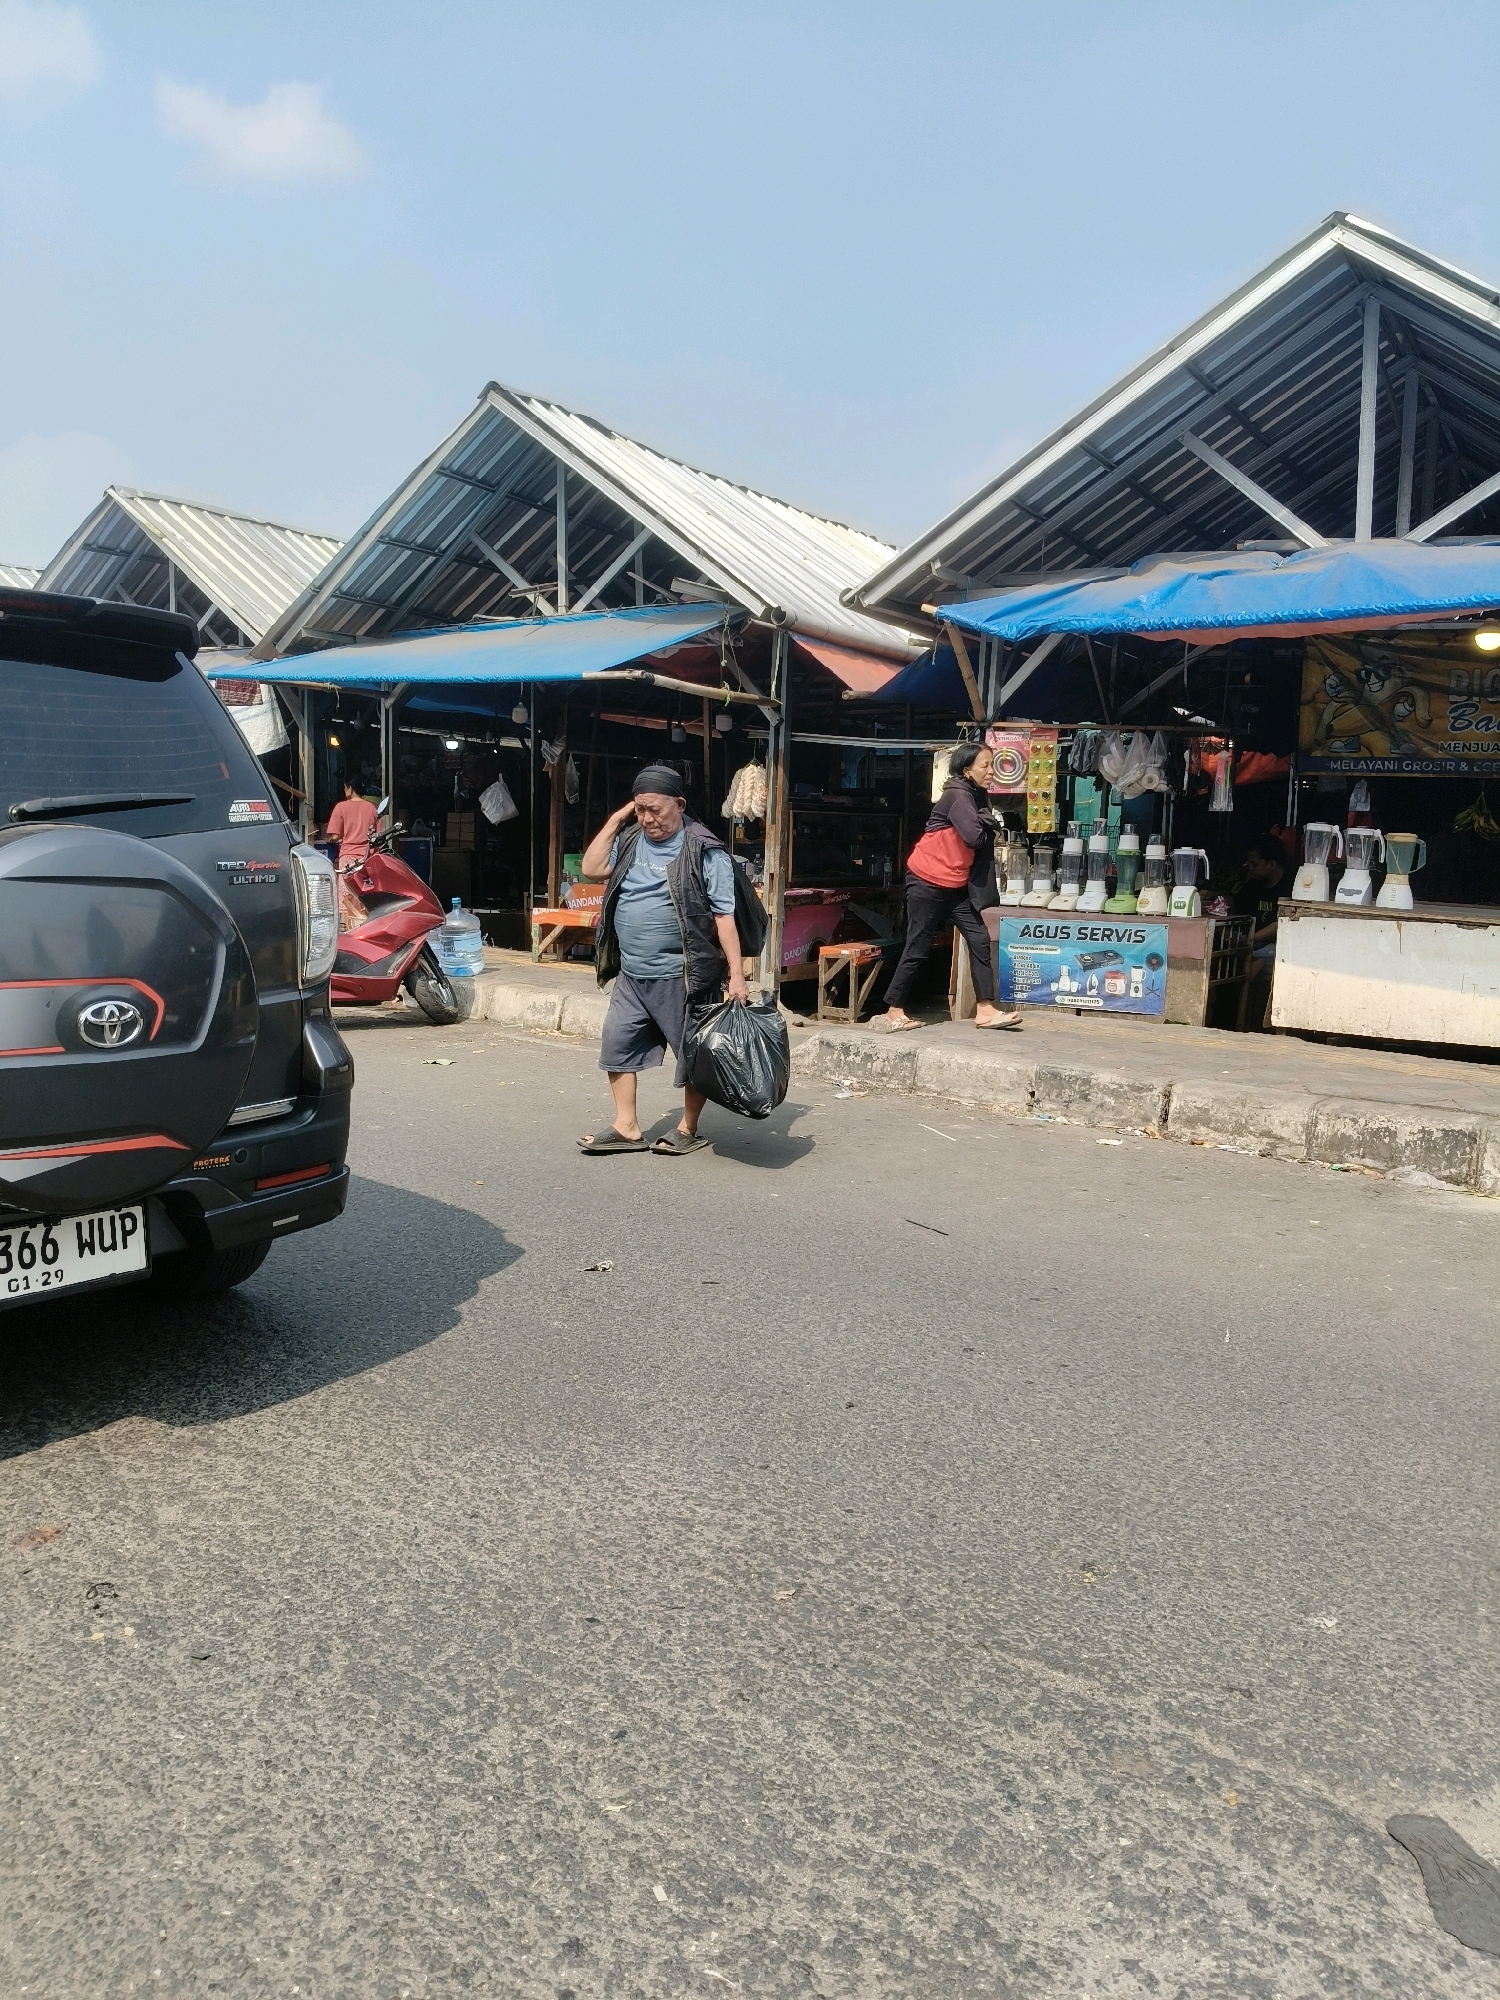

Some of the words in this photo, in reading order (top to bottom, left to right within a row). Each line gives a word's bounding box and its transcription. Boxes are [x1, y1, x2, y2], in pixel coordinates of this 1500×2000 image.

[1447, 701, 1500, 733] Ba
[233, 874, 276, 885] ULTIMO
[1019, 924, 1071, 940] AGUS
[76, 1211, 138, 1259] WUP
